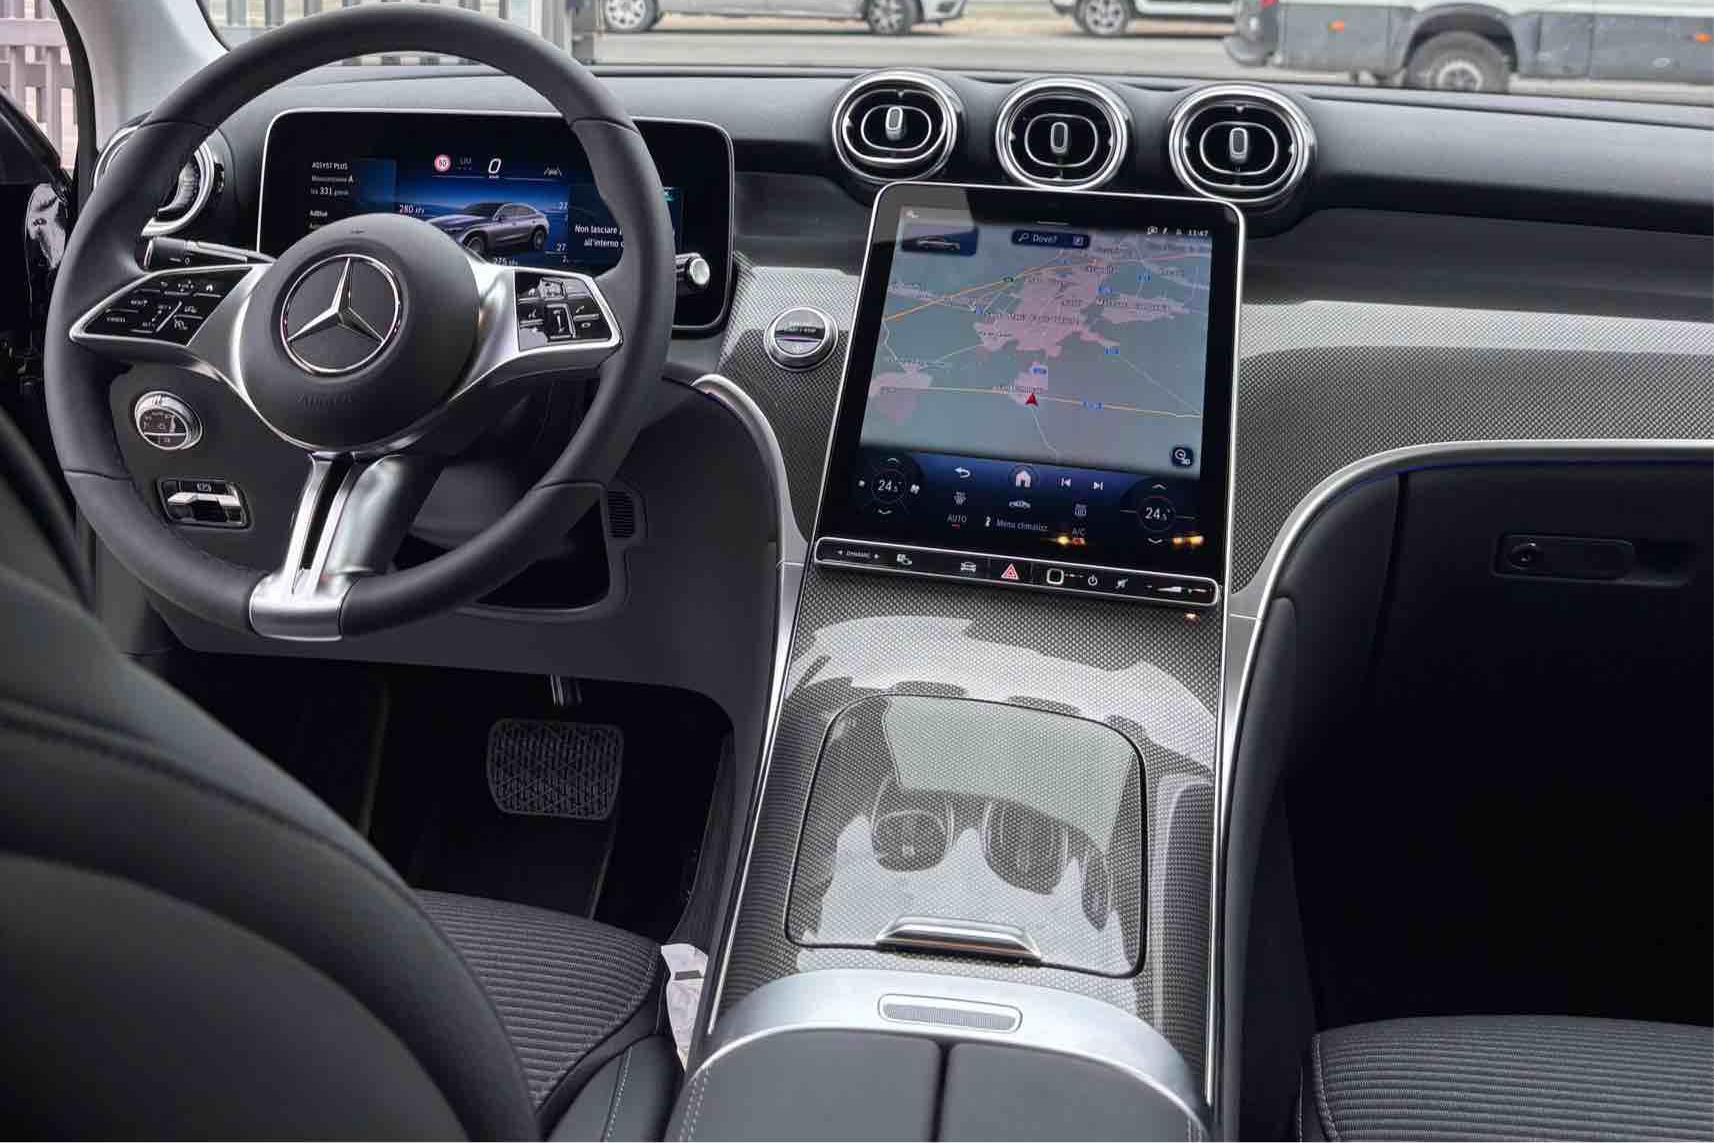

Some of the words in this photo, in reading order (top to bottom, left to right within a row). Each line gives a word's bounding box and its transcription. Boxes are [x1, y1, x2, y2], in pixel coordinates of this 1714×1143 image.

[319, 186, 332, 196] 331
[574, 224, 589, 234] Non
[947, 513, 968, 524] AUTO
